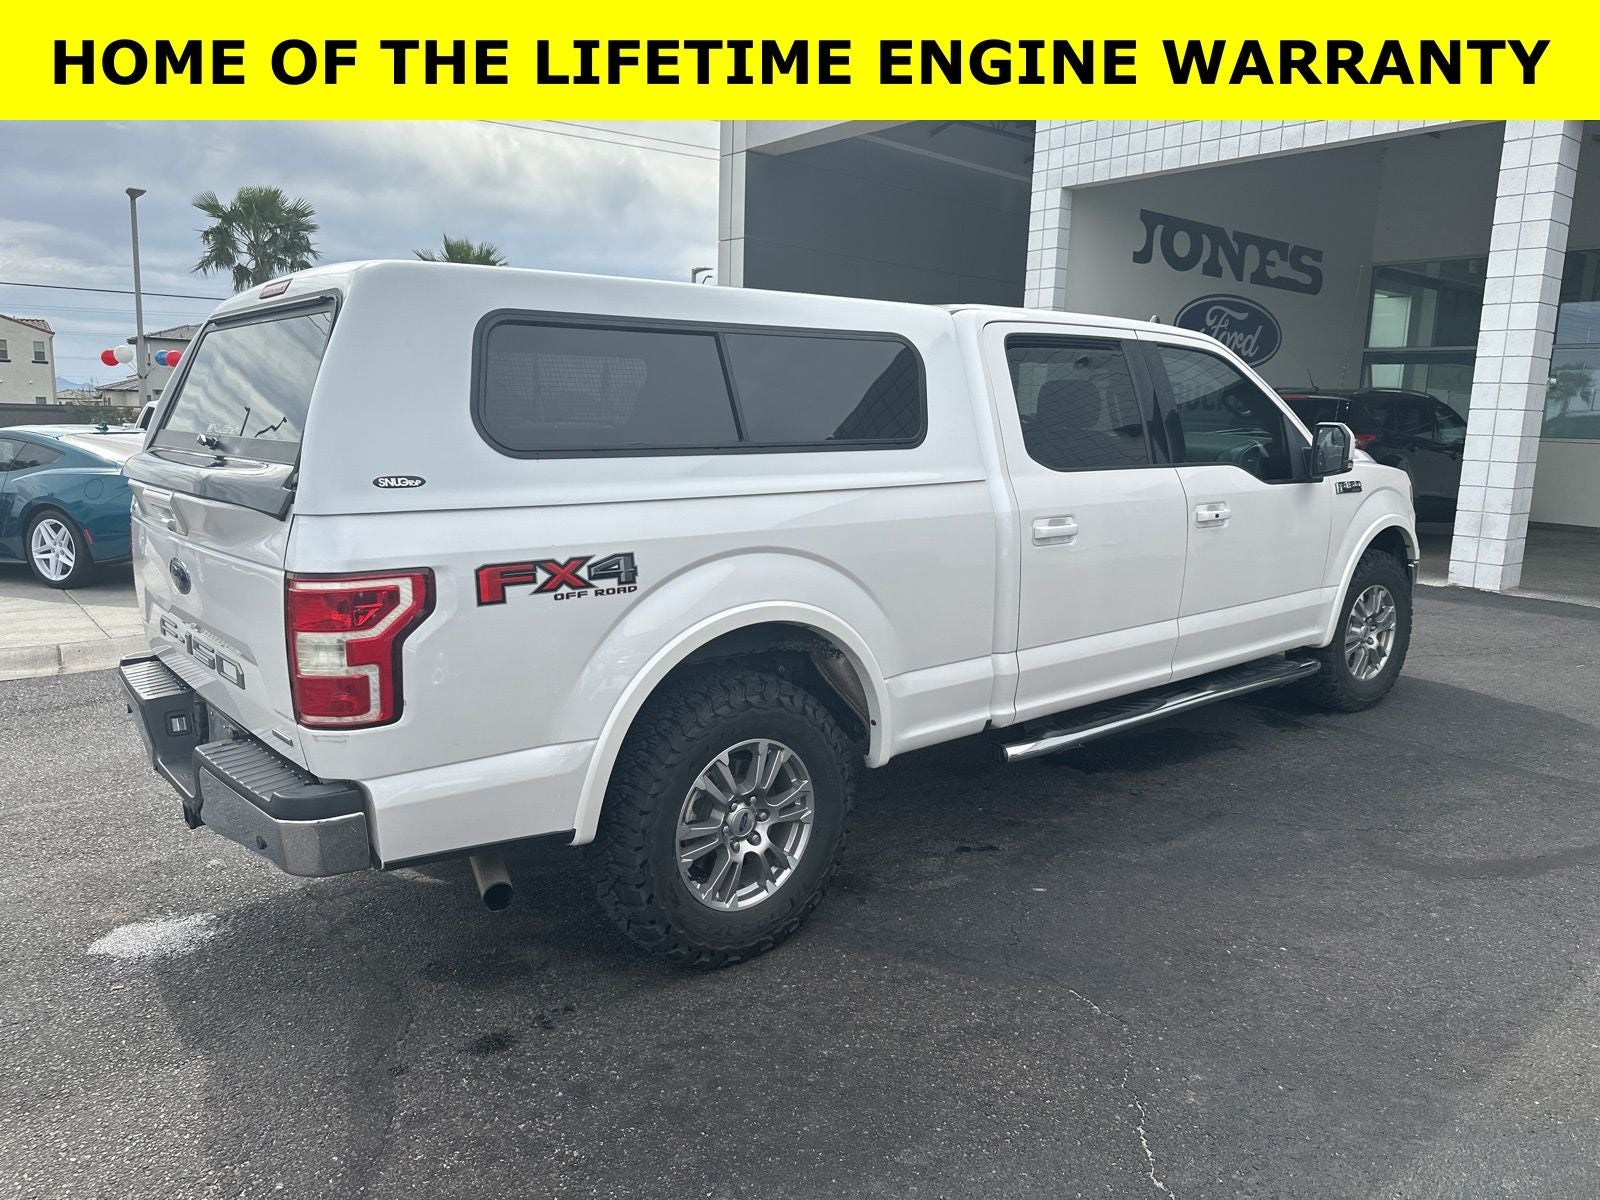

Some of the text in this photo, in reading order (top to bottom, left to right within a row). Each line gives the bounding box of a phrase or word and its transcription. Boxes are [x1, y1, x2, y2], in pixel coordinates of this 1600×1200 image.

[1132, 208, 1324, 297] JONES
[1200, 304, 1263, 359] Ford
[474, 552, 638, 608] FX4
[553, 585, 638, 601] OFF ROAD
[160, 614, 246, 690] F-150
